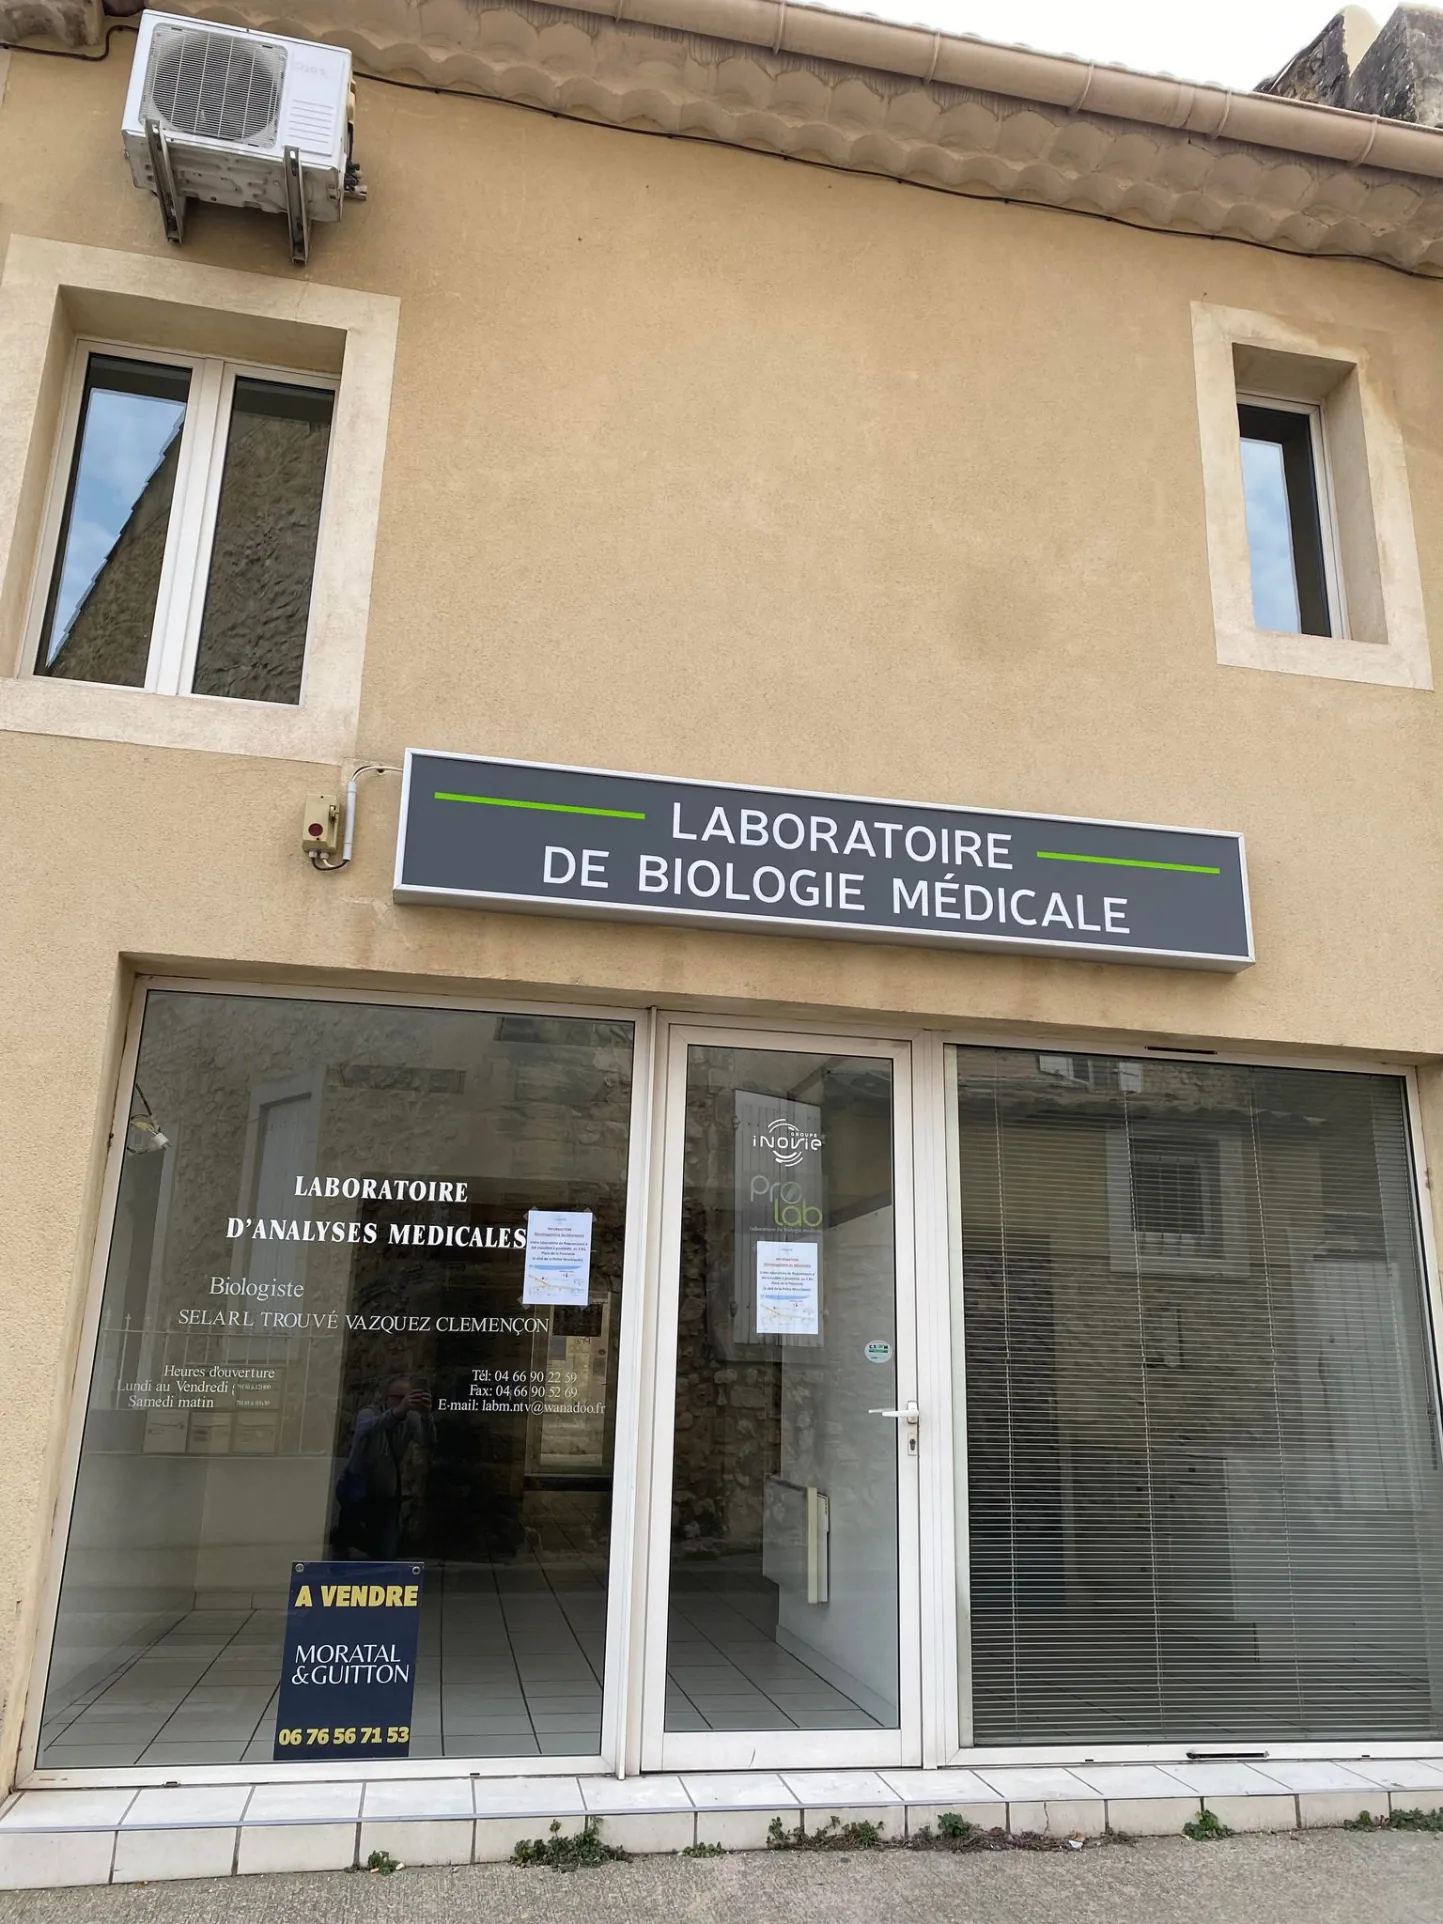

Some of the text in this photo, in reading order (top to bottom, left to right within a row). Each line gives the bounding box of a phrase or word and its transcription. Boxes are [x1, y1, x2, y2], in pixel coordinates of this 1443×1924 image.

[672, 802, 1013, 869] LABORATOIRE
[543, 845, 1130, 933] DE BIOLOGIE MÉDICALE
[790, 1131, 818, 1139] GROUPE
[294, 1175, 468, 1202] LABORATOIRE
[774, 1198, 823, 1227] lab
[225, 1217, 527, 1249] D'ANALYSES MEDICALES
[208, 1276, 305, 1301] Biologiste
[178, 1309, 549, 1336] SELARL TROUVÉ VAZQUEZ CLEMENÇON
[164, 1364, 275, 1379] Heures d'ouverture
[472, 1369, 578, 1384] Tél: 04 66 90 22 59
[117, 1380, 151, 1392] Lundi
[156, 1383, 170, 1392] au
[176, 1381, 229, 1393] Vendredi
[469, 1384, 578, 1399] Fax: 04 66 90 52 69
[128, 1395, 214, 1408] Samedi matin
[438, 1399, 479, 1412] E-mail:
[294, 1585, 419, 1607] A VENDRE
[295, 1644, 401, 1664] MORATAL
[291, 1664, 409, 1685] &GUITTON
[278, 1726, 410, 1746] 06 76 56 71 53
